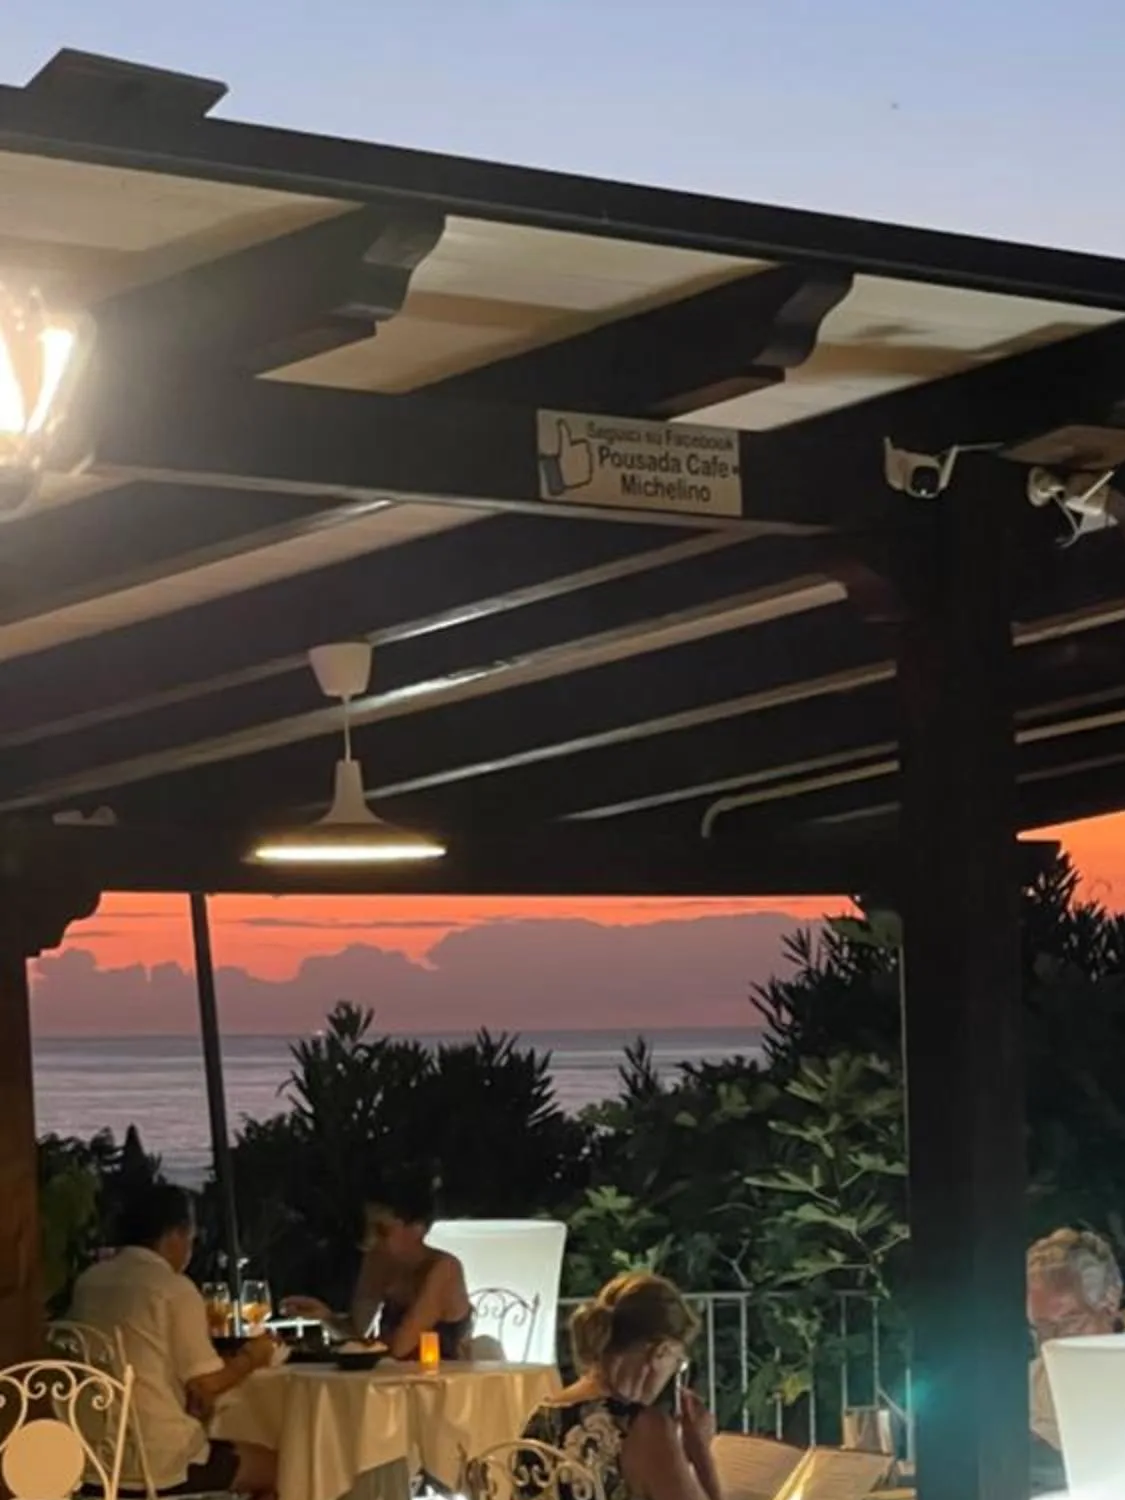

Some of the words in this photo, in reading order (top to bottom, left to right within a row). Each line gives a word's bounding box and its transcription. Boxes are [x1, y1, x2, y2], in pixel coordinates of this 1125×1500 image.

[598, 445, 681, 473] Pousada
[686, 453, 729, 479] Cafe
[620, 472, 711, 502] Michelino
